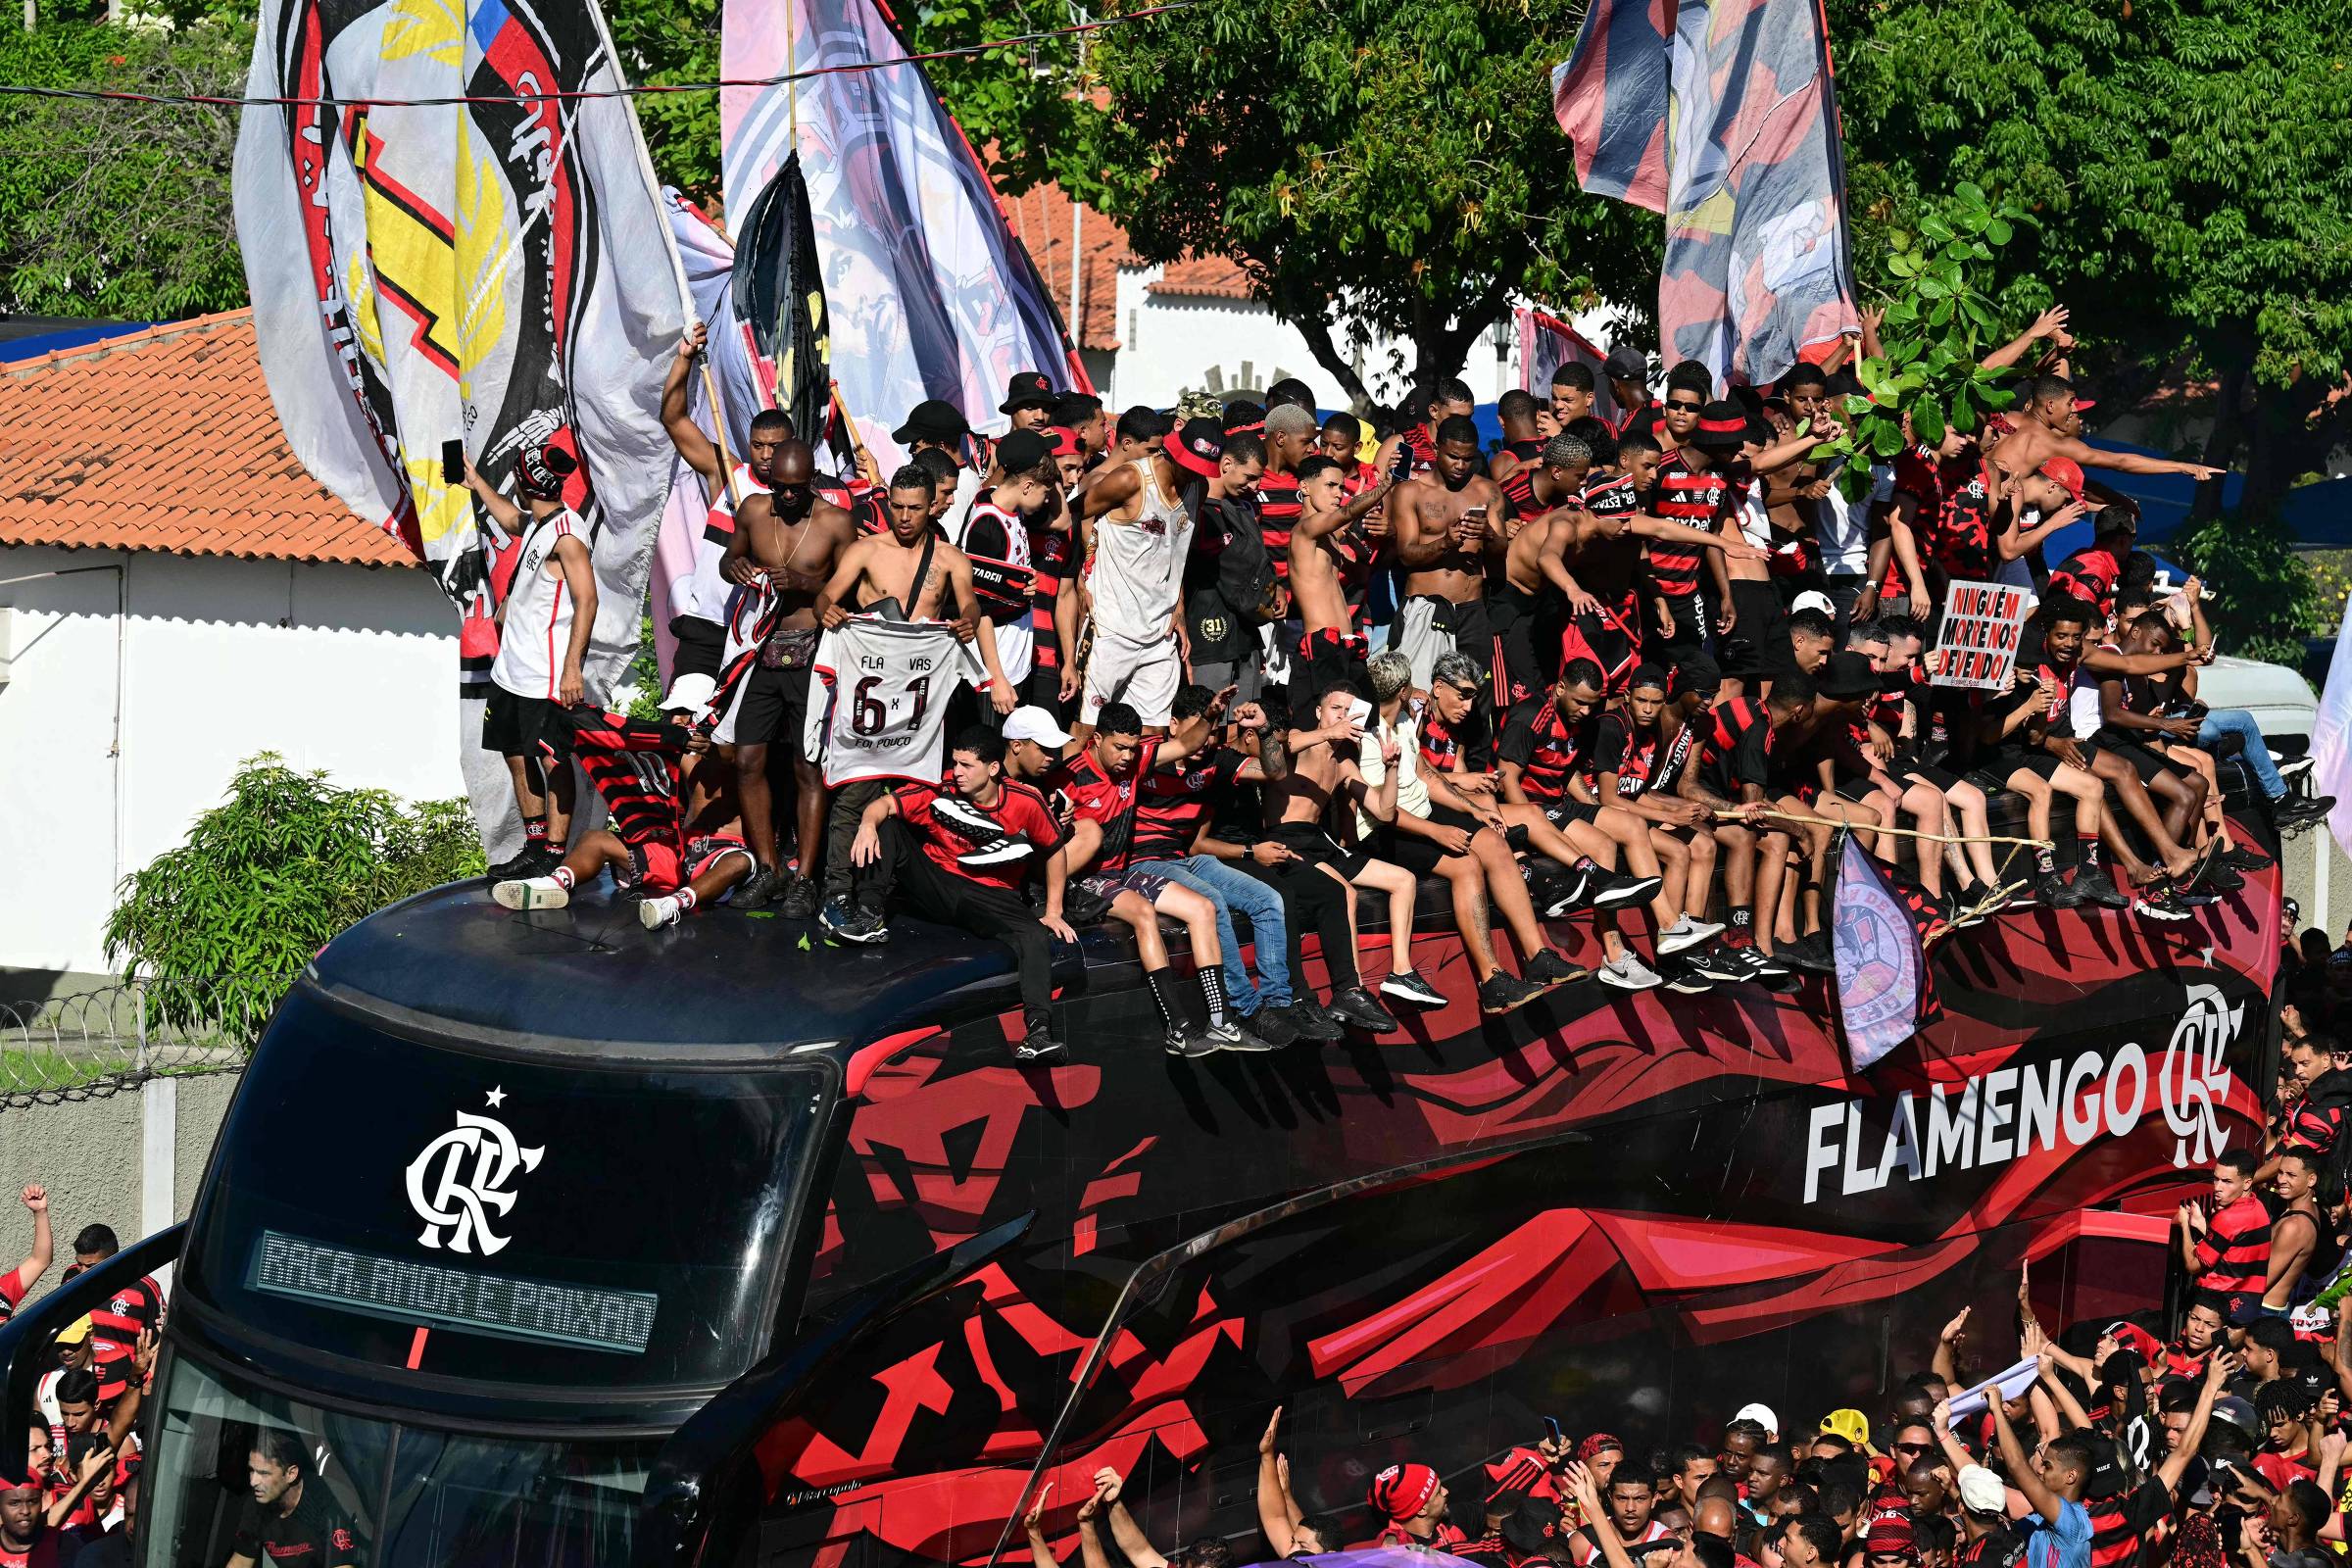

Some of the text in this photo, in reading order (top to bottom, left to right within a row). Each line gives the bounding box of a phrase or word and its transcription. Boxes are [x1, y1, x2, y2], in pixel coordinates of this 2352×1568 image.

[1952, 586, 2021, 620] NINGUÉM
[1205, 618, 1222, 632] 31
[1941, 617, 2019, 652] MORRE NOS
[860, 656, 931, 671] FLA VAS
[1937, 648, 2010, 688] DEVENDO!
[852, 676, 887, 736] 6
[905, 676, 930, 731] 1
[855, 736, 911, 749] FOI POUCO
[1803, 1042, 2148, 1204] FLAMENGO
[369, 1257, 468, 1313] AMOR
[475, 1276, 503, 1320] E
